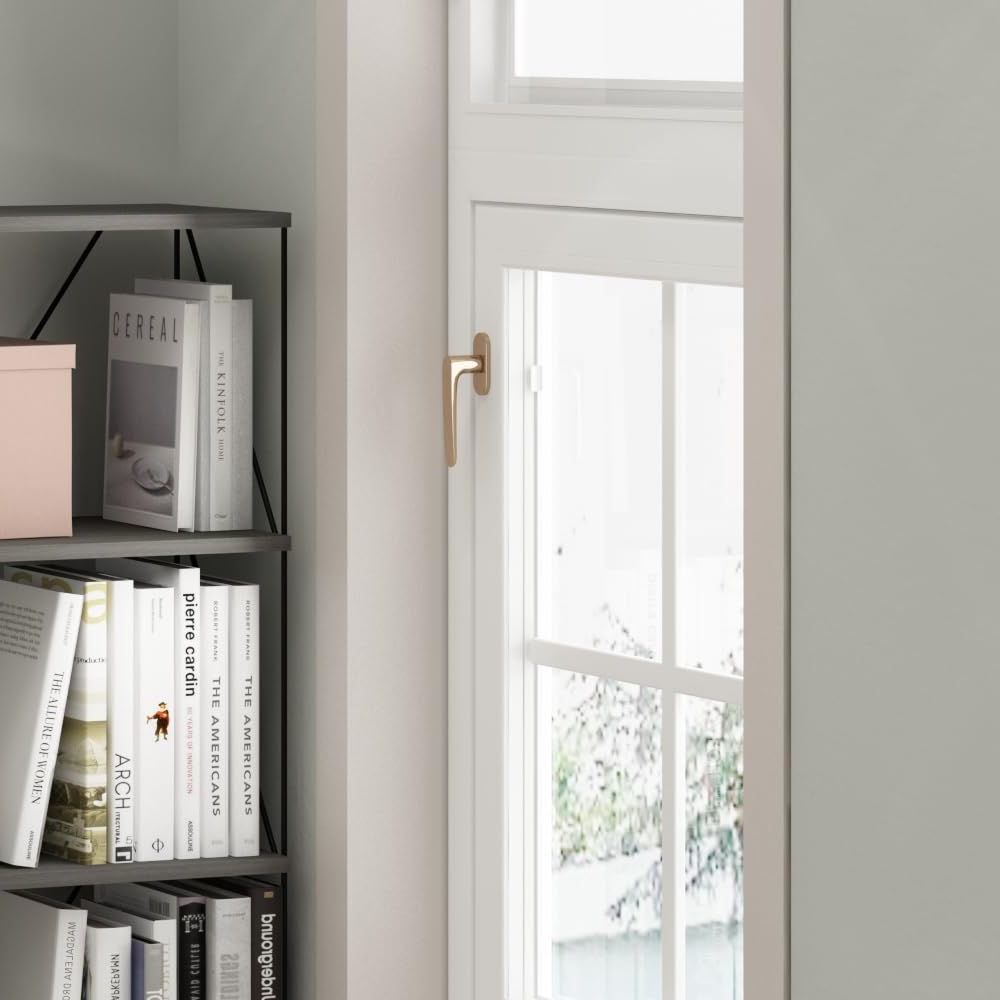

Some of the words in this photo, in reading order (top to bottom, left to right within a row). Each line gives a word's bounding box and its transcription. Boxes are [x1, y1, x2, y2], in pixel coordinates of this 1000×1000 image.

[112, 311, 179, 344] CEREAL
[216, 372, 226, 434] KINFOLK
[182, 593, 198, 641] pierre
[50, 671, 65, 695] THE
[185, 646, 198, 697] cardin
[211, 676, 220, 708] THE
[244, 676, 253, 707] THE
[41, 697, 59, 740] ALLURE
[38, 742, 50, 758] OF
[211, 715, 221, 816] AMERICANS
[244, 714, 253, 816] AMERICANS
[30, 760, 48, 805] WOMEN
[114, 754, 131, 809] ARCH
